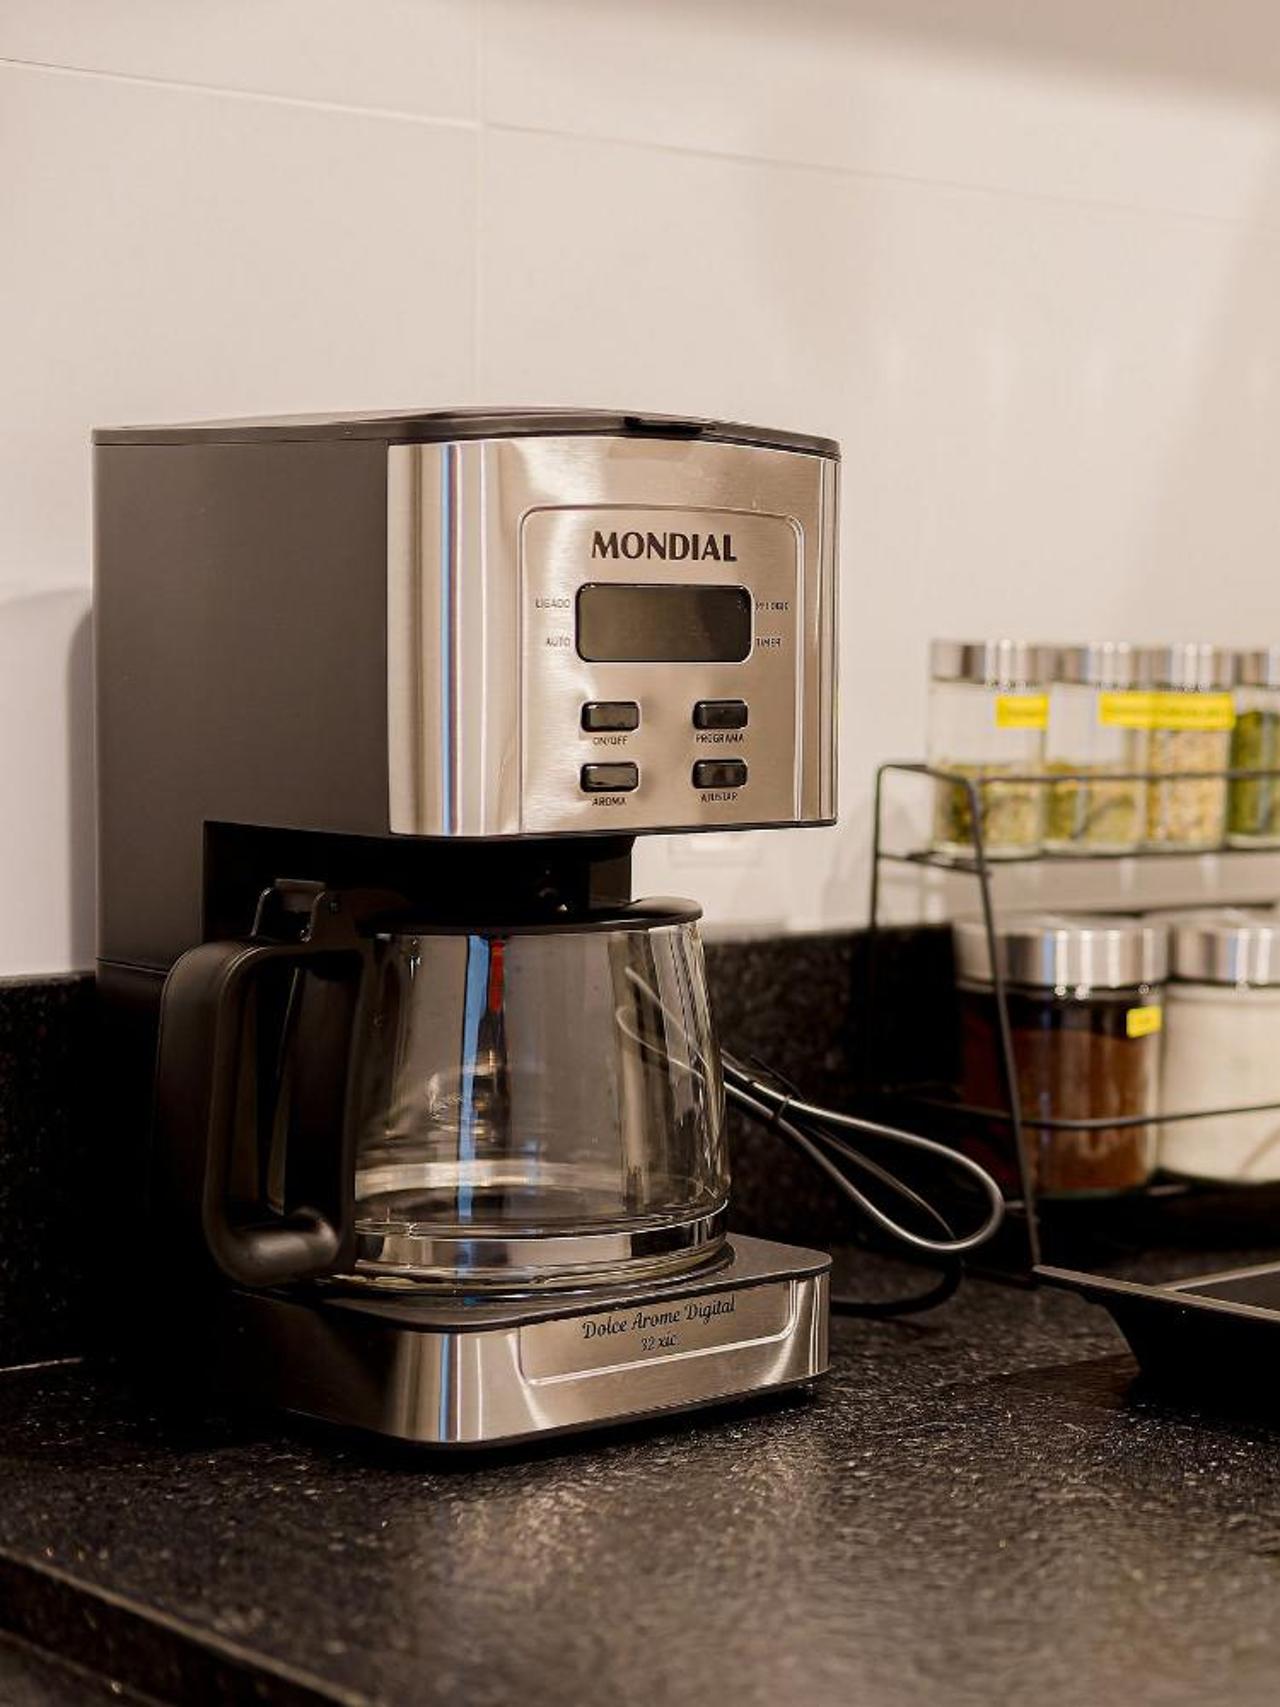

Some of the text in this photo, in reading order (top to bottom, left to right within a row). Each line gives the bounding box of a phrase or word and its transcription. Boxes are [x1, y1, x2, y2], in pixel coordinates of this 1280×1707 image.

[591, 531, 737, 562] MONDIAL
[545, 636, 571, 648] AUTO
[592, 735, 628, 746] ON/OFF
[695, 733, 745, 744] PROGRAMA
[592, 796, 627, 807] AROMA
[582, 1294, 736, 1339] Dolce Arome Digital
